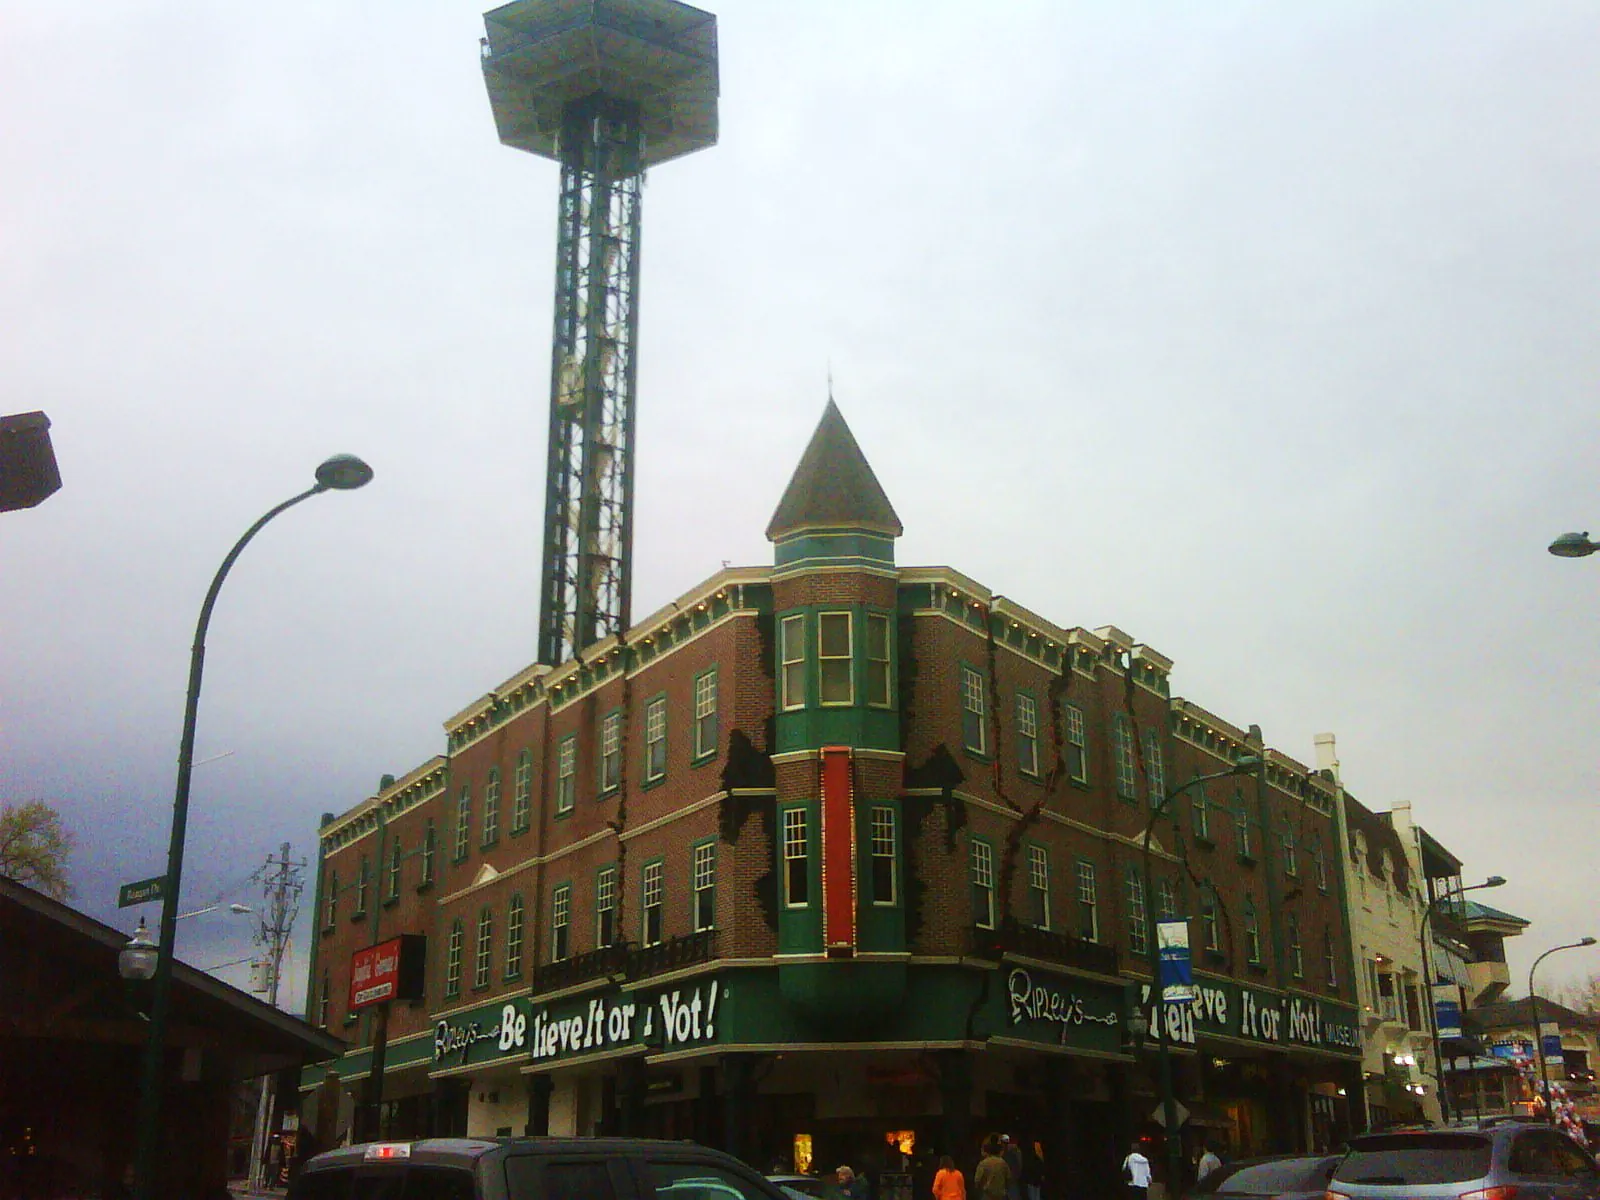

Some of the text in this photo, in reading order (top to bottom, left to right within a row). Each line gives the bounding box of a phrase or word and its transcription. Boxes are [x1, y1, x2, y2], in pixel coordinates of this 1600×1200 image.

[583, 999, 605, 1048] It
[608, 1003, 636, 1042] or
[1008, 968, 1118, 1044] Ripley's
[1242, 991, 1258, 1037] It
[1261, 1007, 1280, 1040] or
[1281, 998, 1321, 1043] Not!
